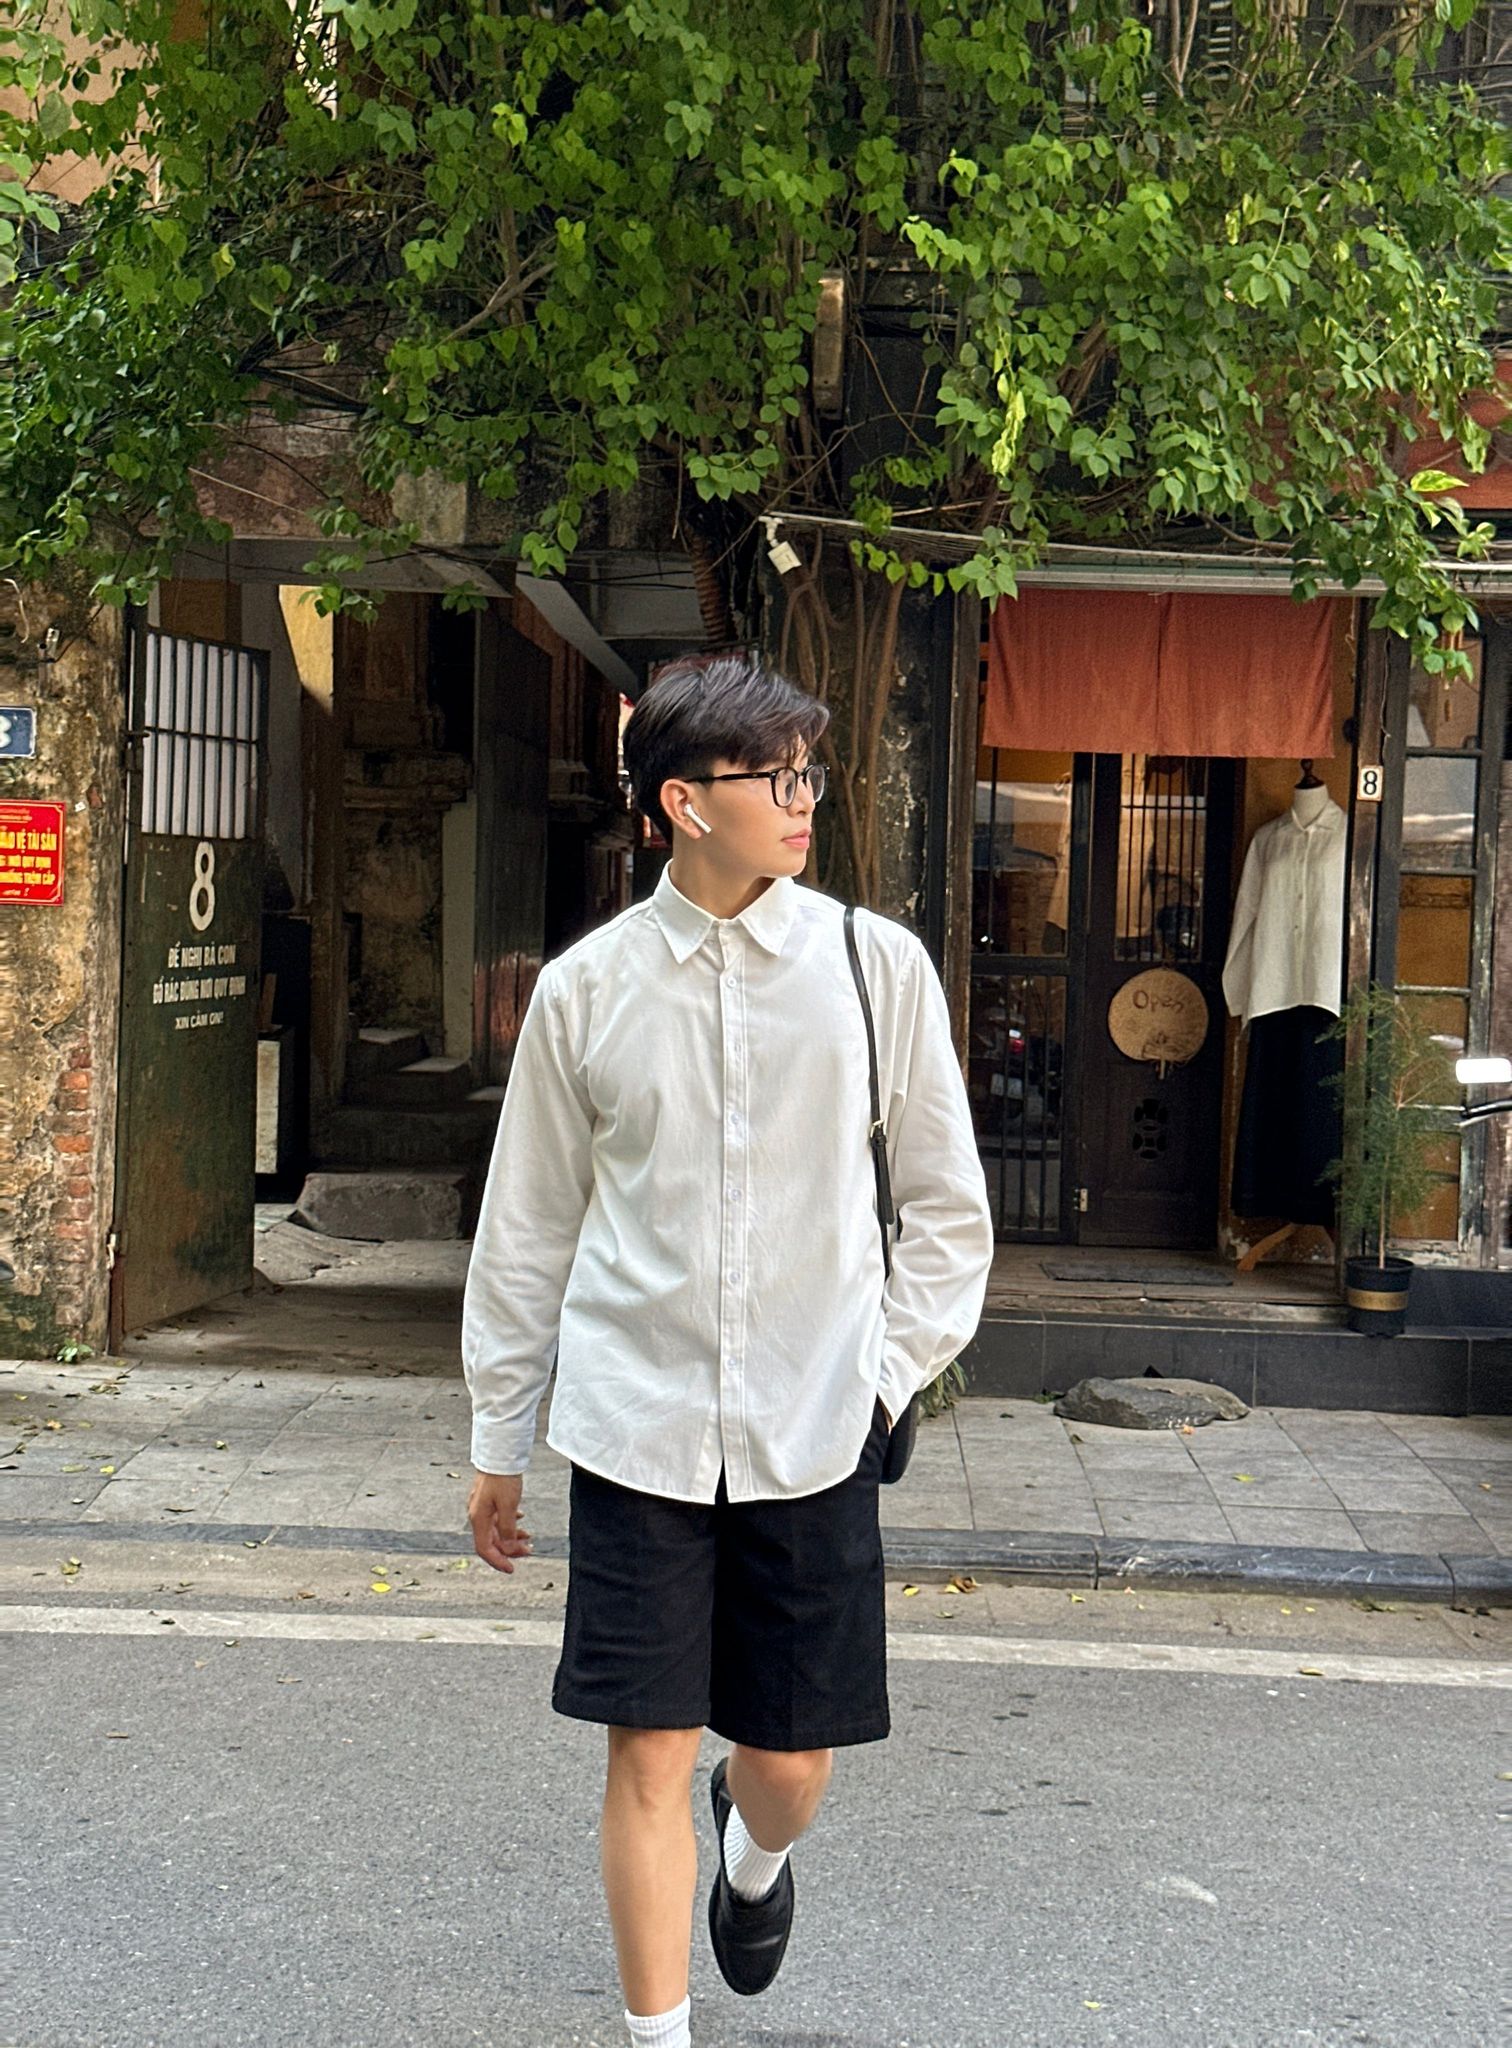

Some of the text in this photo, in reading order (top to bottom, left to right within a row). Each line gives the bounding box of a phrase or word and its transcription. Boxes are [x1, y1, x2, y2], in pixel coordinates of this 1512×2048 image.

[1363, 770, 1378, 796] 8
[189, 841, 216, 931] 8
[181, 946, 203, 971] NGHỊ
[218, 944, 236, 965] CON
[164, 977, 179, 1003] RÁC
[214, 977, 228, 1000] QUY
[1132, 990, 1184, 1013] Open
[175, 1016, 190, 1029] XIN
